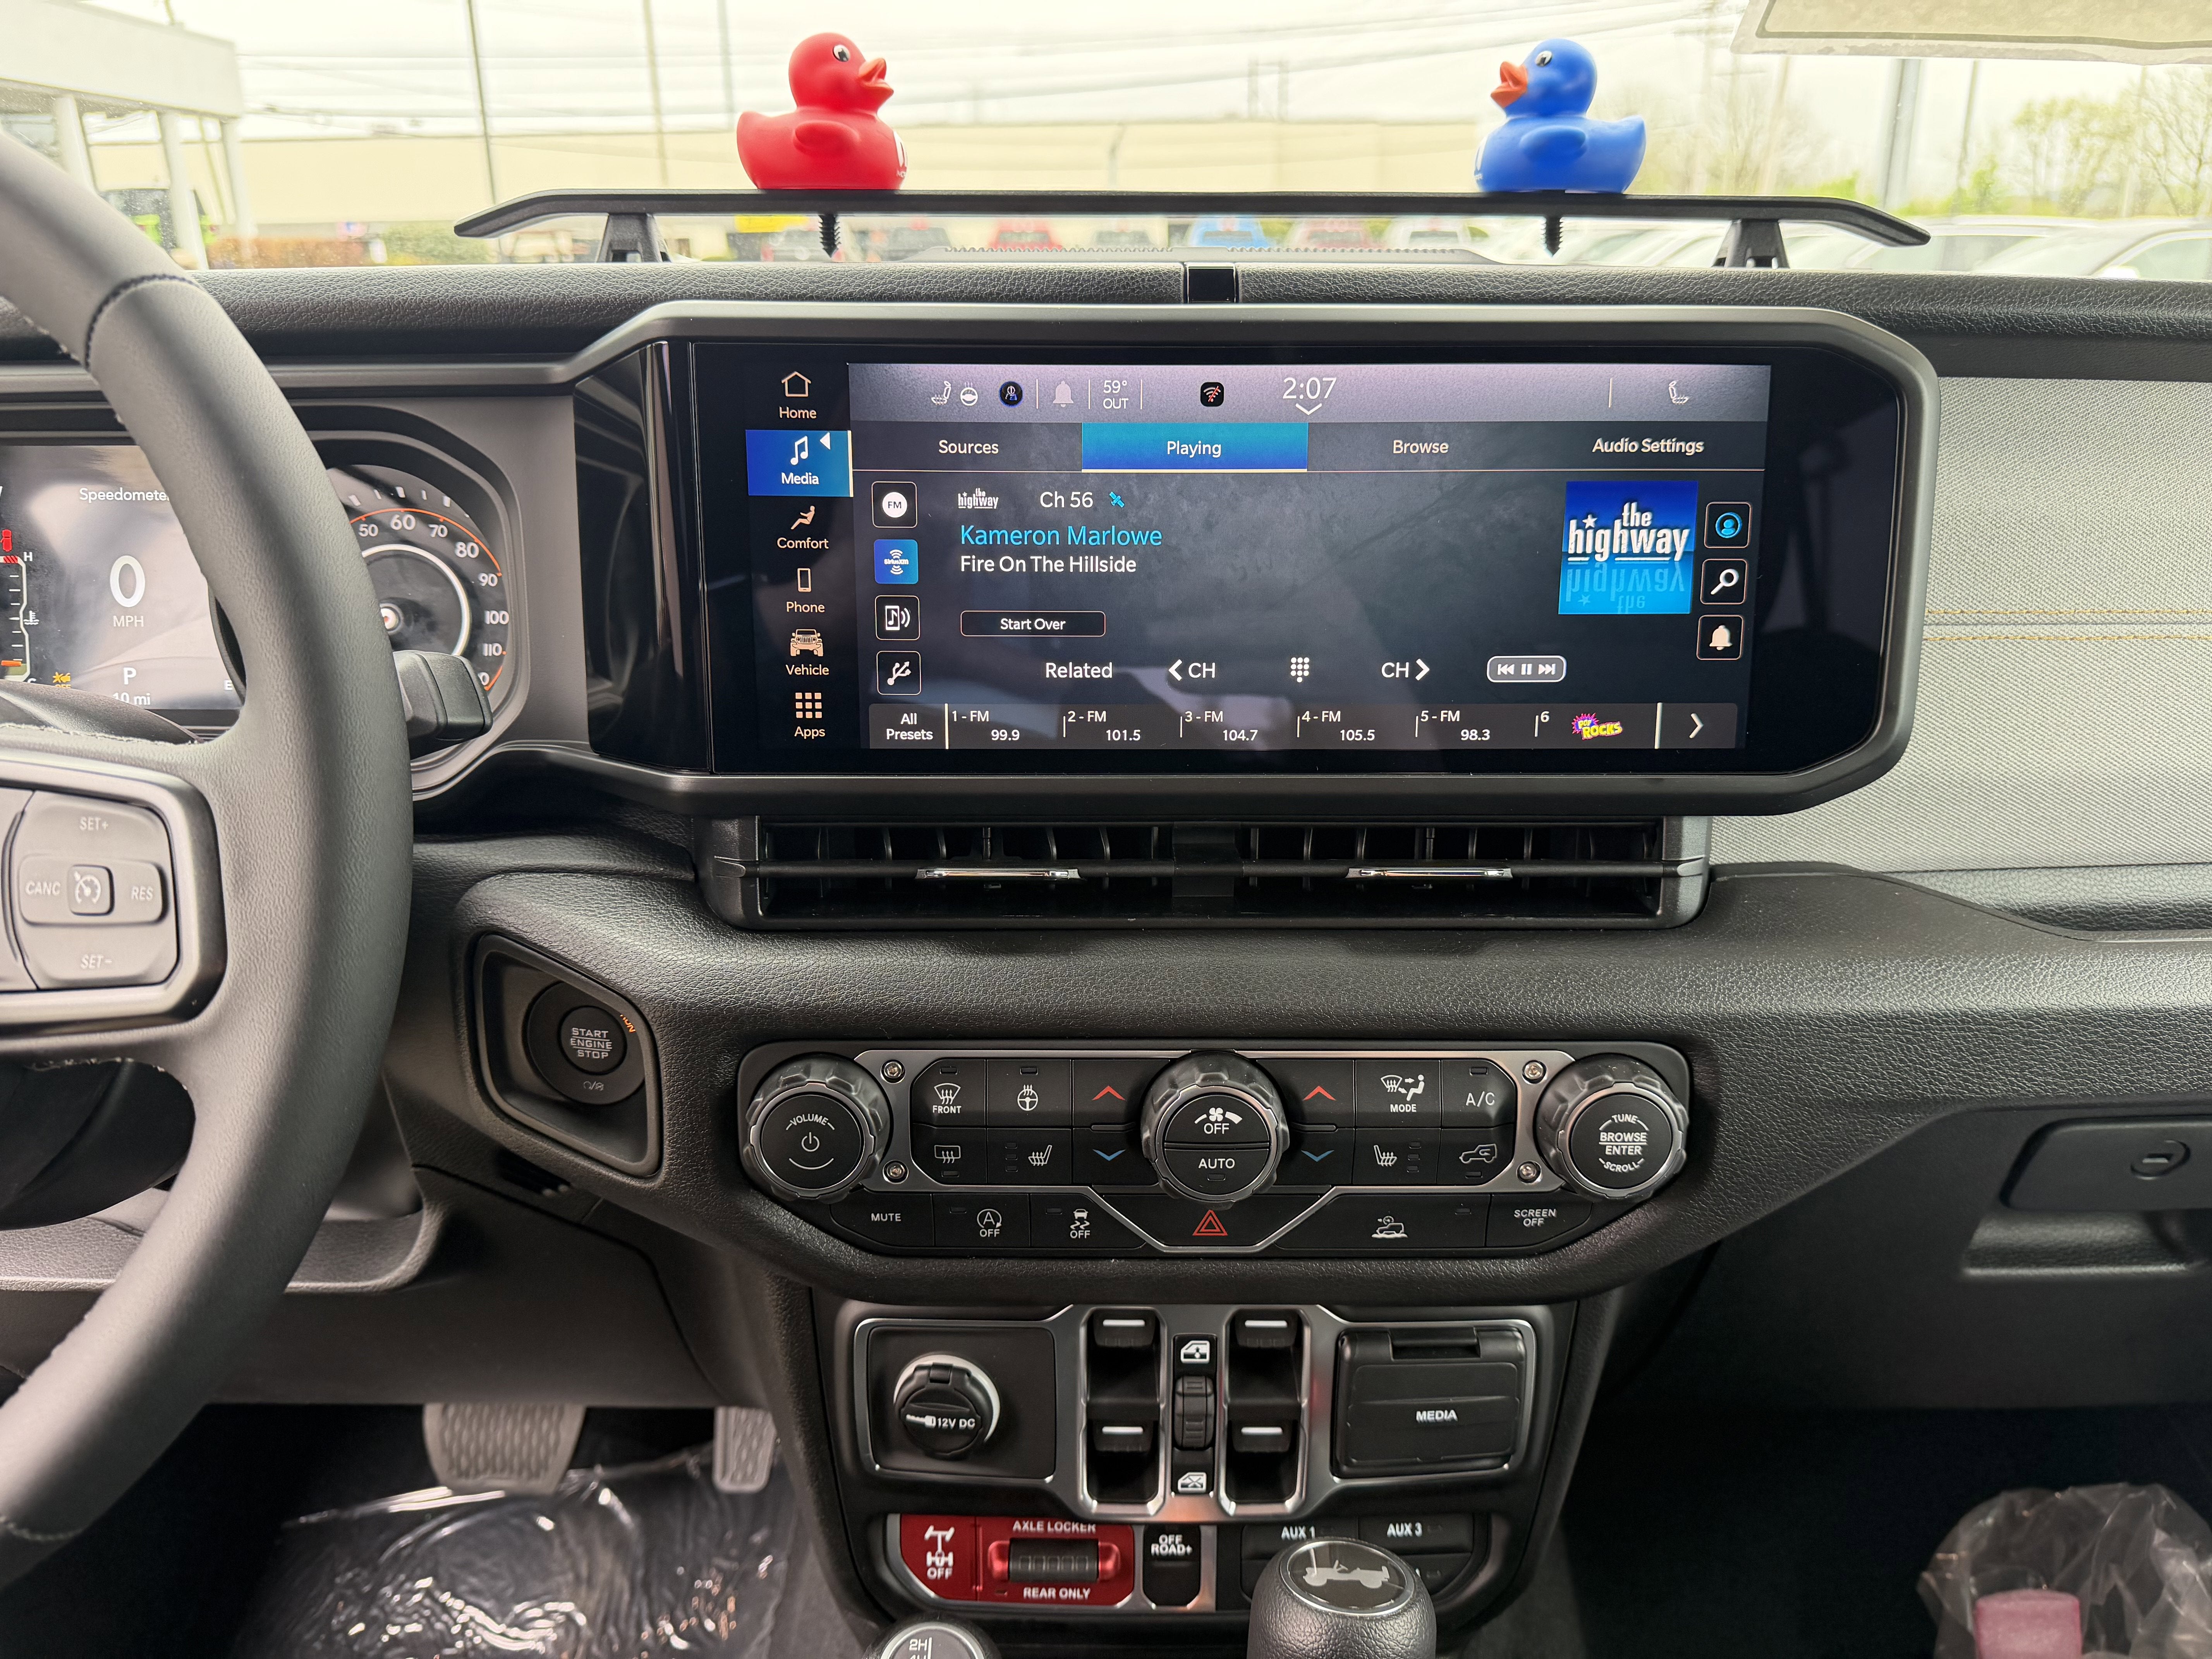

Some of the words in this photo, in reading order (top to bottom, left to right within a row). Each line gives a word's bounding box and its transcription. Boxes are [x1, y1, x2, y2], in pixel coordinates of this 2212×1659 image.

[1103, 380, 1127, 393] 59°
[1283, 377, 1337, 400] 2:07
[1103, 398, 1128, 409] OUT
[779, 407, 817, 419] Home
[939, 440, 999, 455] Sources
[1167, 441, 1221, 458] Playing
[1393, 440, 1449, 454] Browse
[1592, 438, 1638, 453] Audio
[1641, 438, 1704, 455] Settings
[781, 472, 819, 485] Media
[79, 488, 169, 503] Speedomete
[976, 488, 986, 496] the
[888, 501, 902, 509] FM
[958, 491, 999, 509] highway
[1040, 491, 1064, 508] Ch
[1070, 492, 1093, 508] 56
[1623, 502, 1652, 527] the
[390, 514, 416, 530] 60
[359, 524, 378, 537] 50
[429, 524, 448, 538] 70
[961, 525, 1060, 545] Kameron
[1068, 525, 1162, 546] Marlowe
[777, 537, 829, 549] Comfort
[1568, 514, 1690, 562] highway
[455, 541, 479, 558] 80
[24, 551, 33, 562] H
[961, 556, 994, 572] Fire
[999, 556, 1026, 572] On
[1030, 556, 1064, 572] The
[1070, 556, 1137, 573] Hillside
[110, 555, 145, 607] 0
[478, 573, 498, 587] 90
[786, 601, 825, 613] Phone
[113, 616, 144, 627] MPH
[485, 611, 509, 624] 100
[1000, 618, 1031, 630] Start
[1034, 618, 1066, 630] Over
[483, 643, 502, 656] 110
[786, 664, 829, 675] Vehicle
[1046, 662, 1113, 678] Related
[1188, 663, 1216, 678] CH
[1381, 662, 1409, 678] CH
[123, 667, 137, 685] P
[134, 693, 150, 705] mi
[901, 713, 917, 725] All
[952, 711, 958, 721] 1
[970, 711, 989, 722] FM
[1068, 711, 1075, 722] 2
[1087, 711, 1106, 722] FM
[1185, 711, 1193, 722] 3
[1204, 711, 1223, 722] FM
[1302, 711, 1310, 722] 4
[1322, 711, 1341, 722] FM
[1421, 711, 1429, 722] 5
[1441, 711, 1460, 722] FM
[1540, 711, 1549, 723] 6
[794, 726, 826, 739] Apps
[886, 729, 933, 740] Presets
[991, 730, 1020, 741] 99.9
[1106, 730, 1141, 741] 101.5
[1223, 730, 1258, 741] 104.7
[1340, 730, 1375, 741] 105.5
[1461, 729, 1490, 741] 98.3
[1582, 723, 1623, 738] ROCKS
[80, 817, 109, 831] SET+
[25, 880, 61, 896] CANC
[131, 886, 153, 901] RES
[572, 1027, 608, 1038] START
[570, 1038, 612, 1049] ENGINE
[577, 1050, 609, 1059] STOP
[1466, 1091, 1495, 1107] A/C
[933, 1106, 962, 1114] FRONT
[1390, 1104, 1417, 1113] MODE
[790, 1113, 829, 1126] VOLUME
[1612, 1114, 1638, 1124] TUNE
[1204, 1123, 1229, 1134] OFF
[1600, 1132, 1647, 1142] BROWSE
[1606, 1145, 1642, 1156] ENTER
[1199, 1158, 1235, 1169] AUTO
[1603, 1161, 1640, 1172] SCROLL
[871, 1213, 902, 1222] MUTE
[1514, 1209, 1557, 1218] SCREEN
[1523, 1218, 1544, 1228] OFF
[979, 1229, 1000, 1237] OFF
[1070, 1230, 1090, 1239] OFF
[1416, 1410, 1458, 1422] MEDIA
[937, 1418, 956, 1428] 12V
[959, 1419, 975, 1429] DC
[1013, 1520, 1044, 1532] AXLE
[1047, 1521, 1096, 1534] LOCKER
[1281, 1525, 1307, 1540] AUX
[1309, 1526, 1316, 1539] 1
[1387, 1522, 1413, 1537] AUX
[1415, 1522, 1423, 1537] 3
[1159, 1534, 1182, 1545] OFF
[927, 1567, 953, 1580] OFF
[1024, 1587, 1056, 1599] REAR
[1059, 1587, 1091, 1599] ONLY
[909, 1638, 927, 1651] 2H
